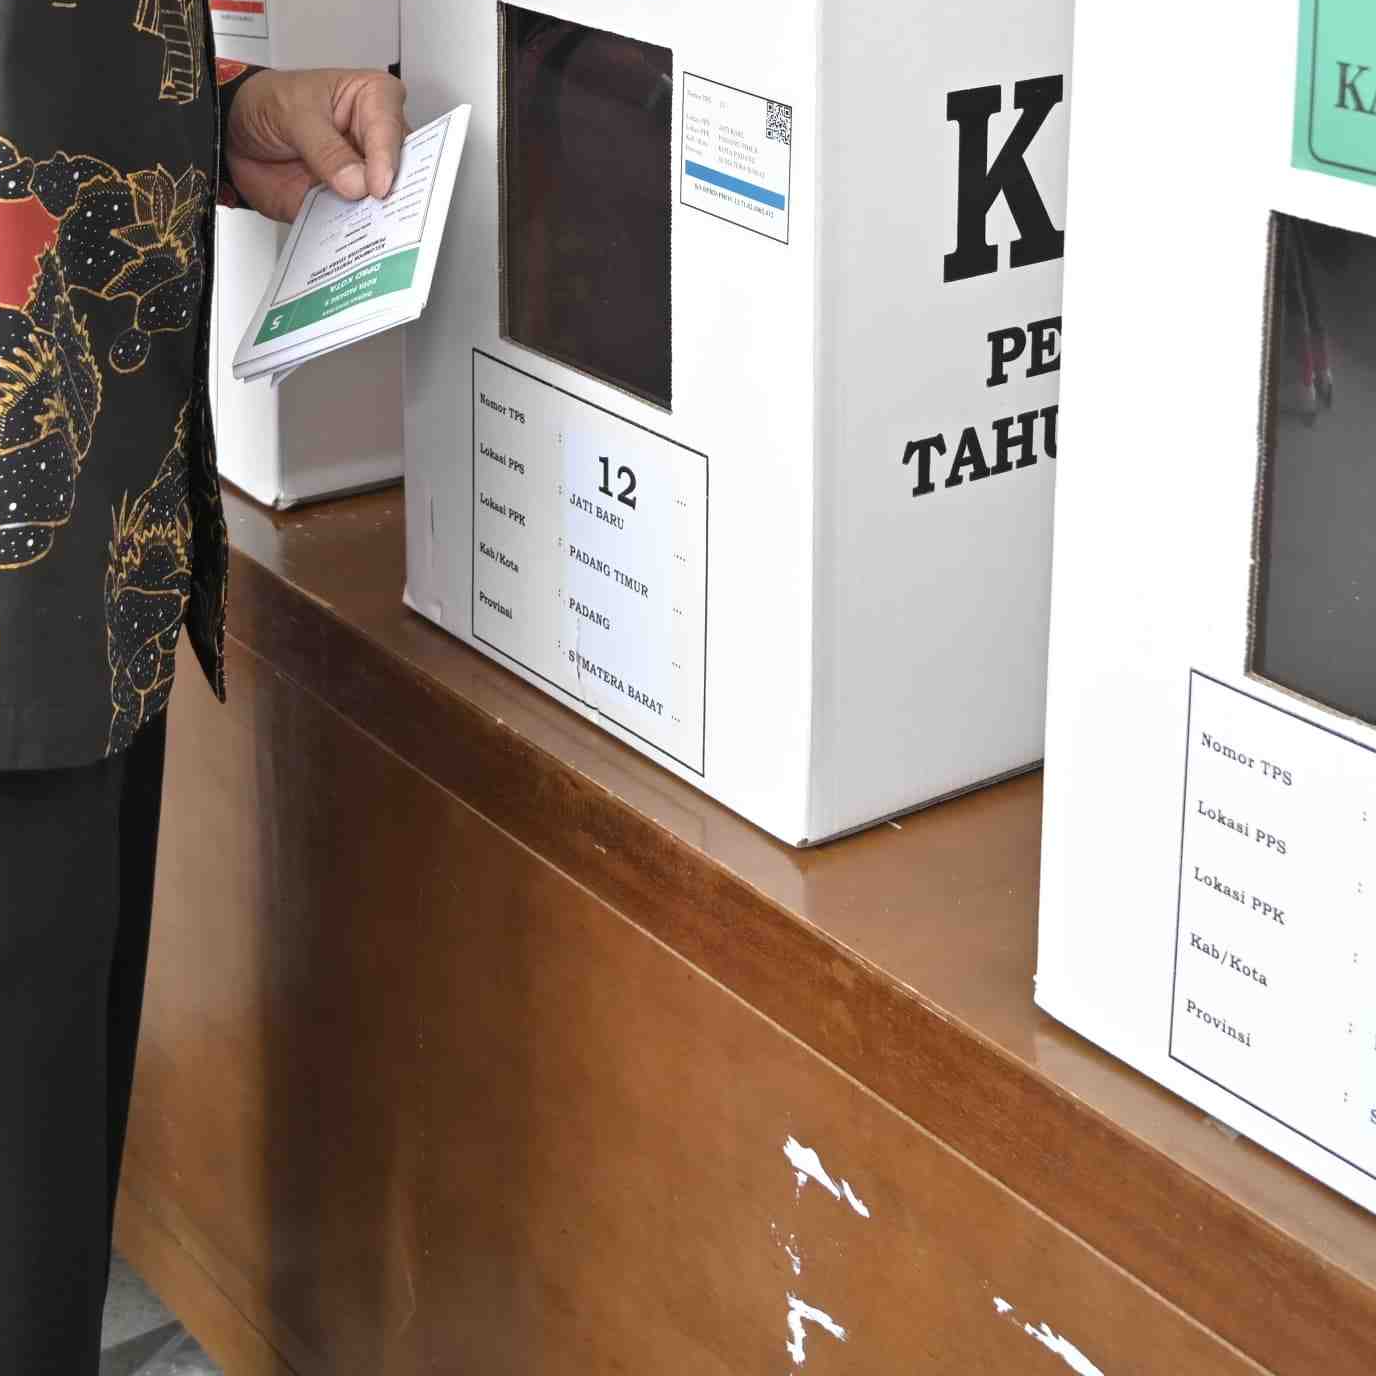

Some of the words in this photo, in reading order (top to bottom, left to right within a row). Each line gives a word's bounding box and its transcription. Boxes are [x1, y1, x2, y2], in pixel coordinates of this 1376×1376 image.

[943, 74, 1064, 283] K
[270, 314, 284, 331] 5
[480, 392, 506, 416] Nomor
[509, 407, 526, 424] TPS
[480, 443, 506, 467] Lokasi
[508, 458, 525, 475] PPS
[598, 455, 637, 511] 12
[480, 492, 506, 516] Lokasi
[508, 509, 526, 527] PPK
[570, 493, 593, 516] JATI
[596, 505, 624, 531] BARU
[479, 541, 519, 573] Kab/Kota
[569, 545, 611, 577] PADANG
[614, 568, 649, 598] TIMUR
[479, 590, 513, 620] Provinsi
[569, 597, 611, 630] PADANG
[628, 684, 664, 717] BARAT
[1201, 731, 1255, 769] Nomor
[1260, 760, 1293, 787] TPS
[1197, 800, 1249, 838] Lokasi
[1255, 828, 1288, 856] PPS
[1193, 866, 1246, 905] Lokasi
[1251, 896, 1286, 926] PPK
[1189, 932, 1268, 987] Kab/Kota
[1186, 998, 1252, 1048] Provinsi
